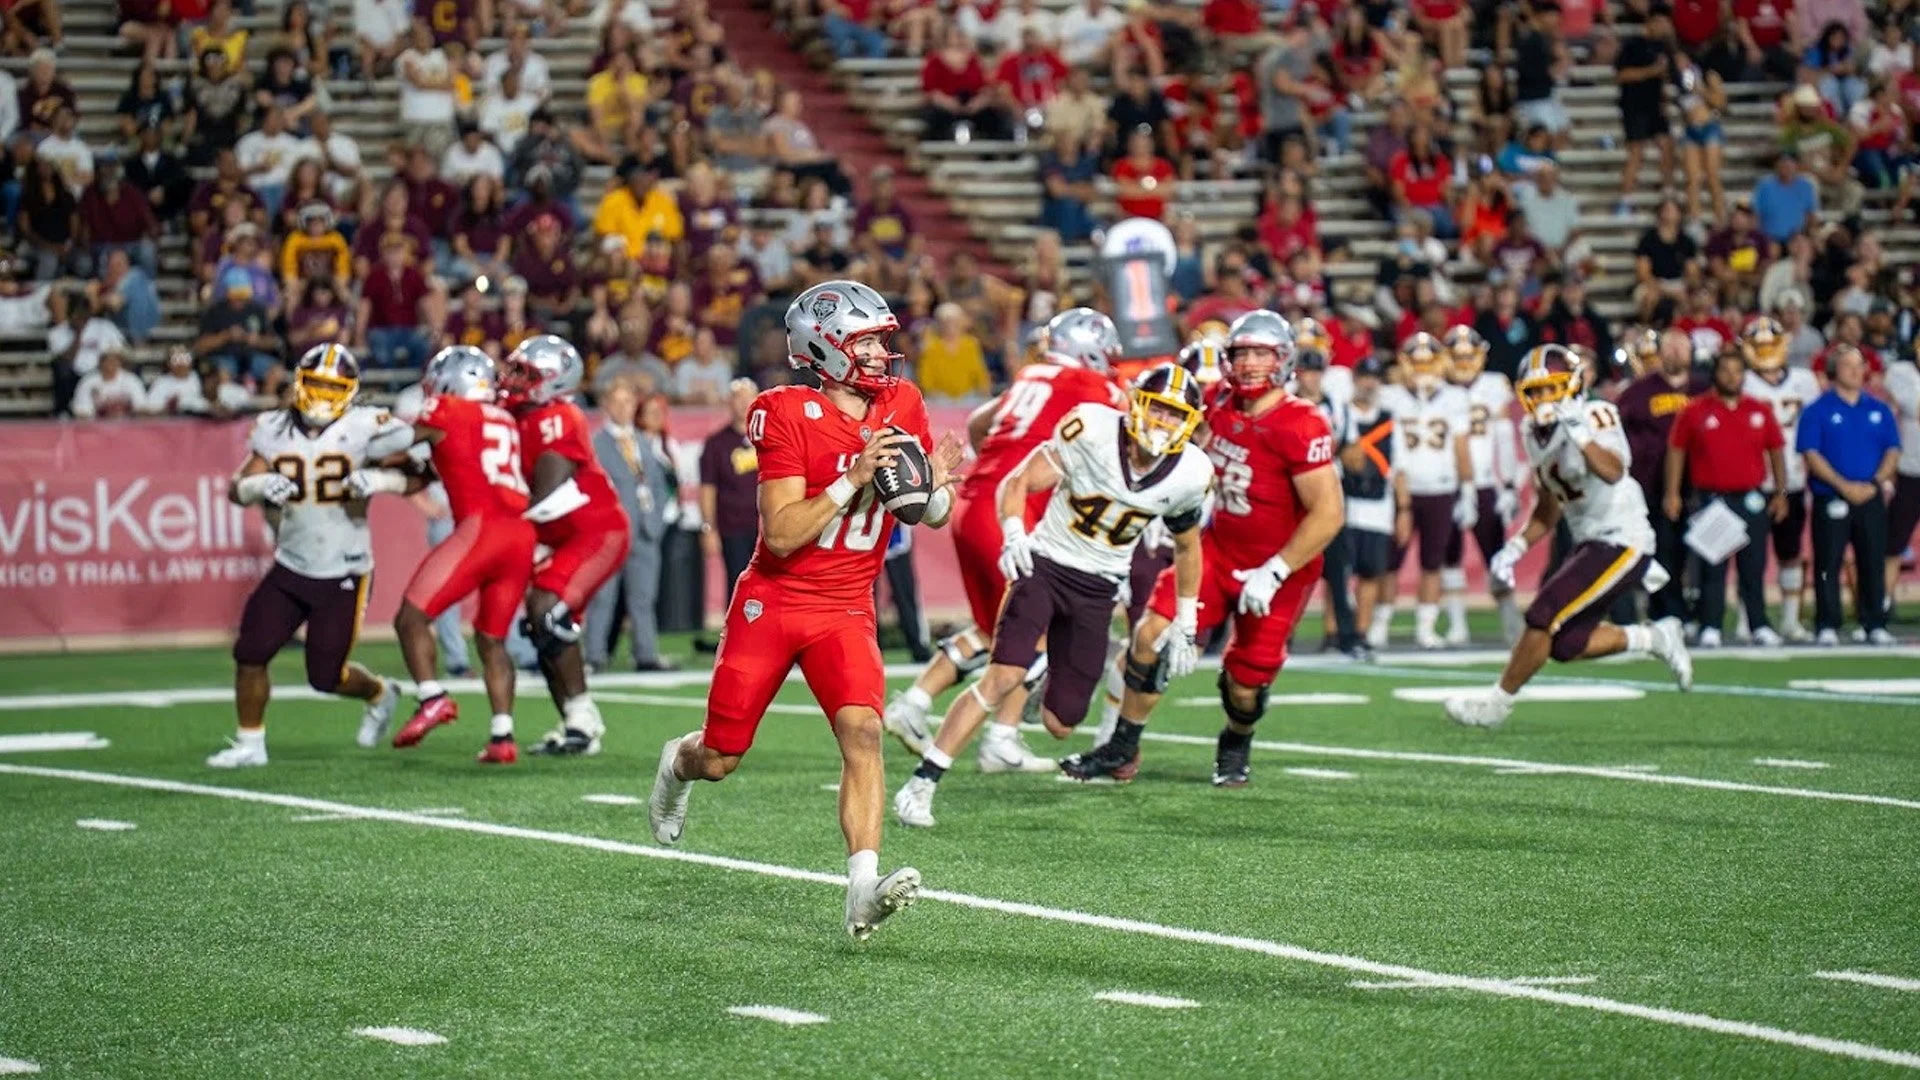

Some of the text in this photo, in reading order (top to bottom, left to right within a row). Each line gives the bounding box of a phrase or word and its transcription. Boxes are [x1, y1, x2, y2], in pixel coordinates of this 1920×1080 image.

[1123, 258, 1157, 320] 1
[1591, 407, 1617, 430] 11
[271, 453, 354, 505] 92
[64, 559, 139, 587] TRIAL
